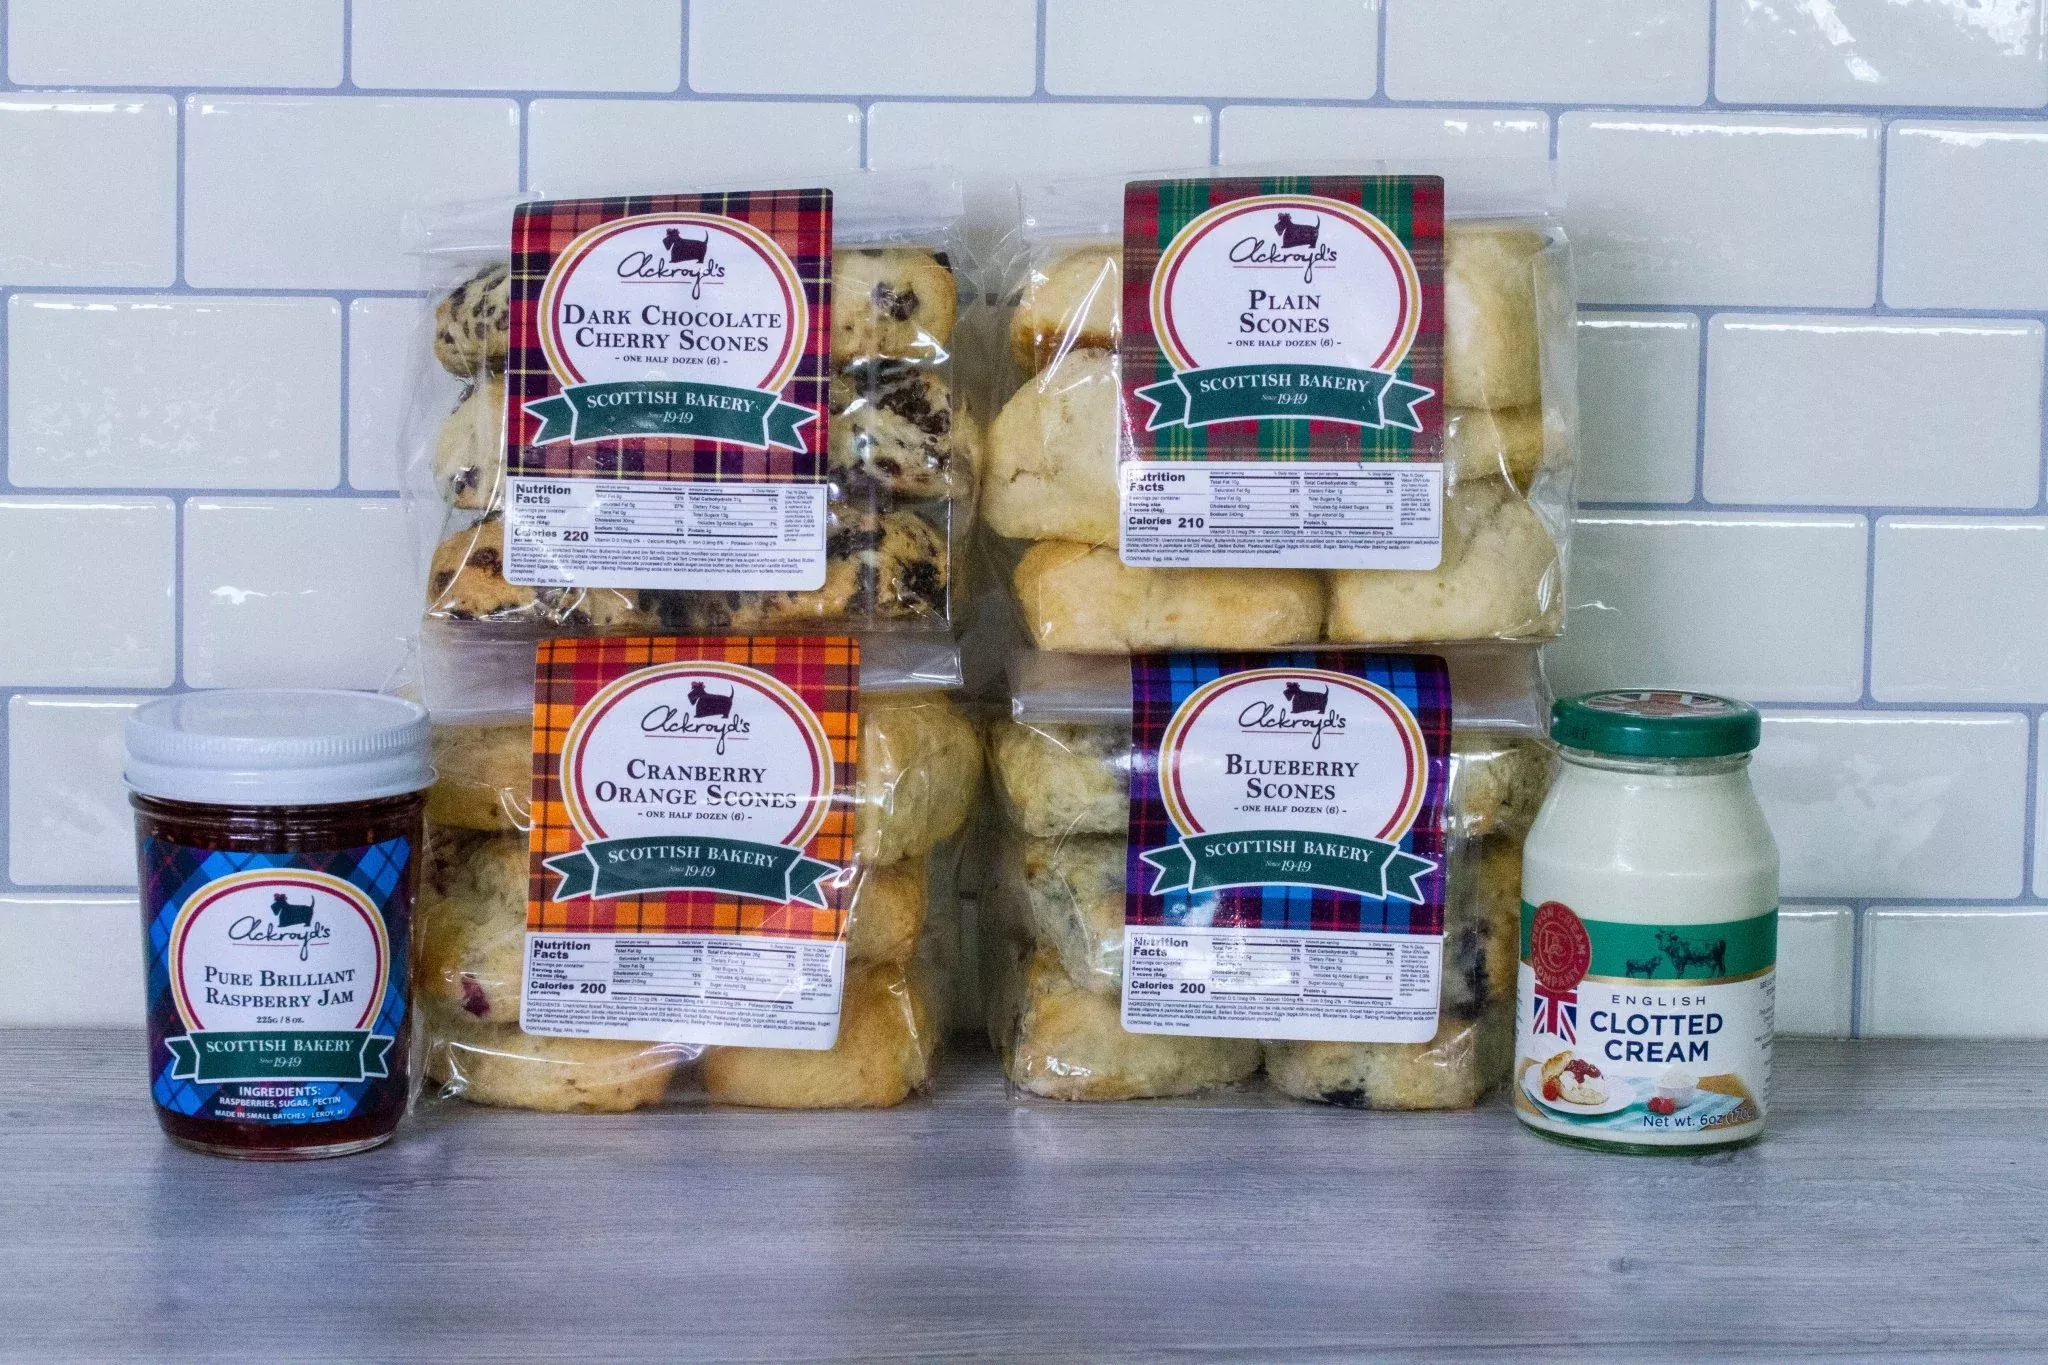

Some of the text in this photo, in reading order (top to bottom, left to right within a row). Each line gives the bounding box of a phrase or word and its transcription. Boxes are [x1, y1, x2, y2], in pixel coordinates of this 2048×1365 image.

[1229, 236, 1337, 283] Ackroyd's
[617, 250, 725, 300] Ackroyd's
[1249, 289, 1320, 310] PLAIN
[563, 304, 781, 328] DARK CHOCOLATE
[1239, 314, 1330, 334] SCONES
[576, 328, 768, 352] CHERRY SCONES
[1320, 339, 1334, 348] (6)
[646, 356, 669, 364] HALF
[707, 356, 720, 365] (6)
[1200, 373, 1370, 392] SCOTTISH BAKERY
[587, 391, 755, 413] SCOTTISH BAKERY
[1277, 393, 1308, 405] 1949
[663, 411, 694, 423] 1949
[516, 484, 570, 494] Nutrition
[1130, 483, 1164, 491] Facts
[516, 495, 550, 503] Facts
[1129, 517, 1204, 528] Calories 210
[515, 529, 589, 541] Calories 220
[641, 705, 750, 755] Ackroyd's
[1238, 702, 1346, 750] Ackroyd's
[627, 759, 767, 783] CRANBERRY
[1225, 754, 1360, 777] BLUEBERRY
[595, 782, 797, 808] ORANGE SCONES
[1246, 778, 1335, 800] SCONES
[1326, 805, 1339, 815] (6)
[731, 812, 745, 821] (6)
[608, 845, 778, 868] SCOTTISH BAKERY
[1205, 840, 1374, 863] SCOTTISH BAKERY
[685, 865, 715, 877] 1949
[1281, 860, 1312, 872] 1949
[229, 915, 330, 961] Ackroyd's
[534, 941, 590, 950] Nutrition
[1133, 947, 1167, 956] Facts
[534, 950, 569, 959] Facts
[205, 966, 355, 987] PURE BRILLIANT
[531, 982, 606, 994] Calories 200
[1132, 981, 1205, 993] Calories 200
[206, 987, 354, 1007] RASPBERRY JAM
[1613, 995, 1706, 1006] ENGLISH
[1590, 1011, 1723, 1035] CLOTTED
[206, 1039, 353, 1053] SCOTTISH BAKERY
[1605, 1041, 1708, 1062] CREAM
[273, 1056, 302, 1068] 1949
[240, 1087, 320, 1097] INGREDIENTS:
[220, 1097, 277, 1108] RASPBERRIES,
[313, 1097, 340, 1106] PECTIN
[215, 1110, 235, 1118] MADE
[1643, 1115, 1668, 1127] Net
[1674, 1116, 1695, 1127] wt.
[1700, 1114, 1723, 1125] 6oz
